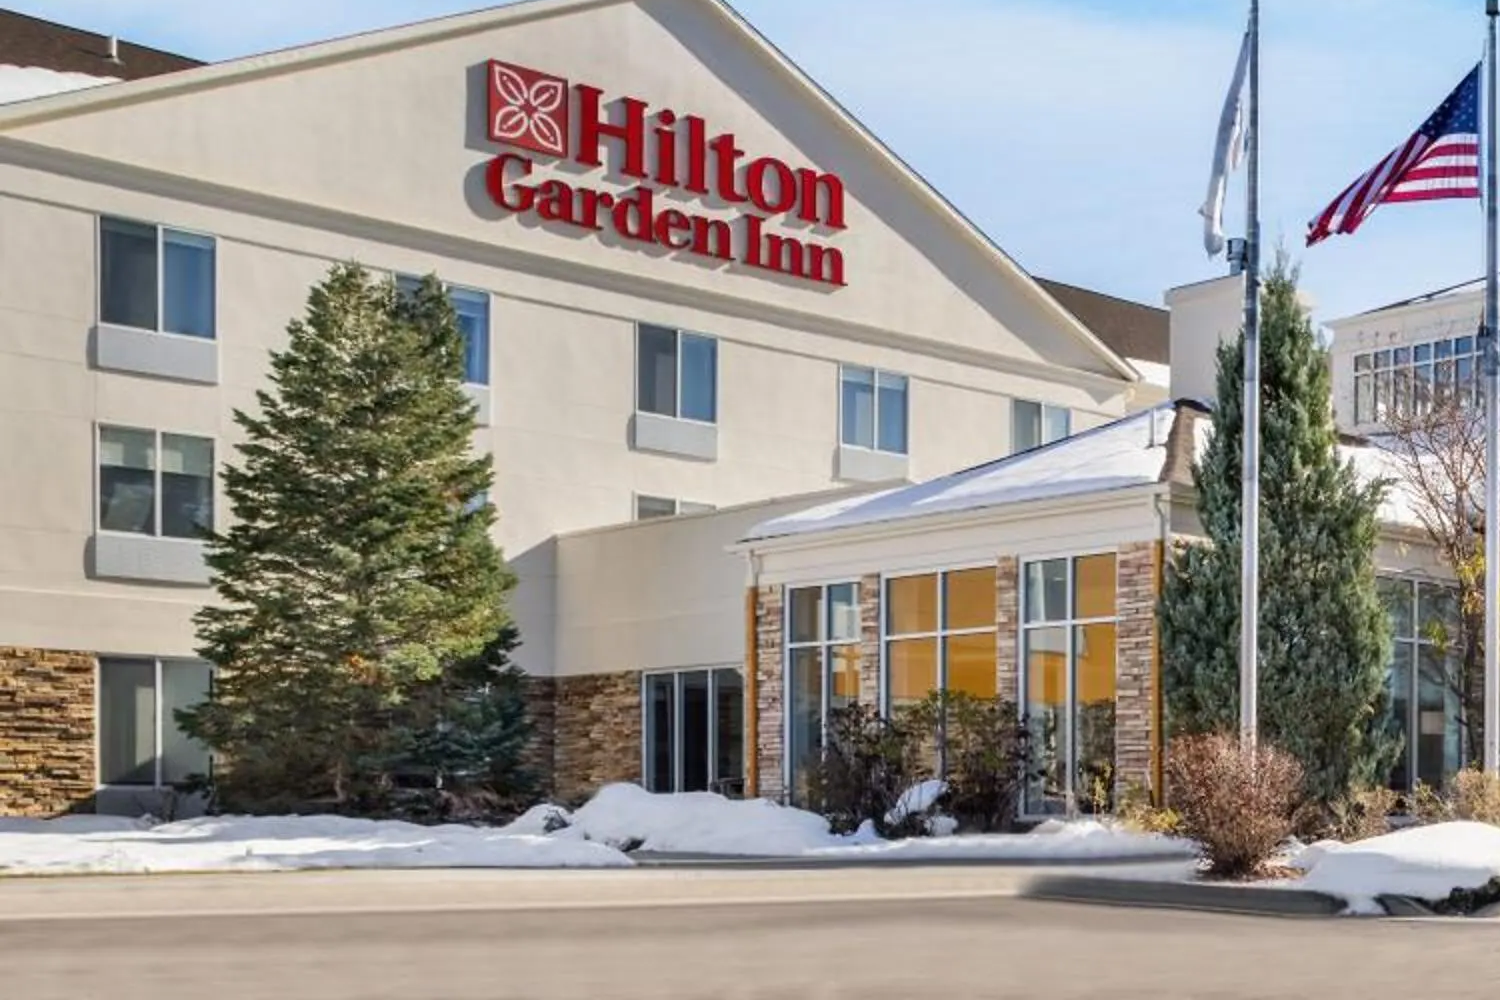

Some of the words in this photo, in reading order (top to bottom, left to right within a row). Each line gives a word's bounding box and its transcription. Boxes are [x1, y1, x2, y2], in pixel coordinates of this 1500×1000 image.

[487, 153, 735, 260] Garden
[744, 214, 848, 286] Inn
[574, 84, 847, 229] Hilton
